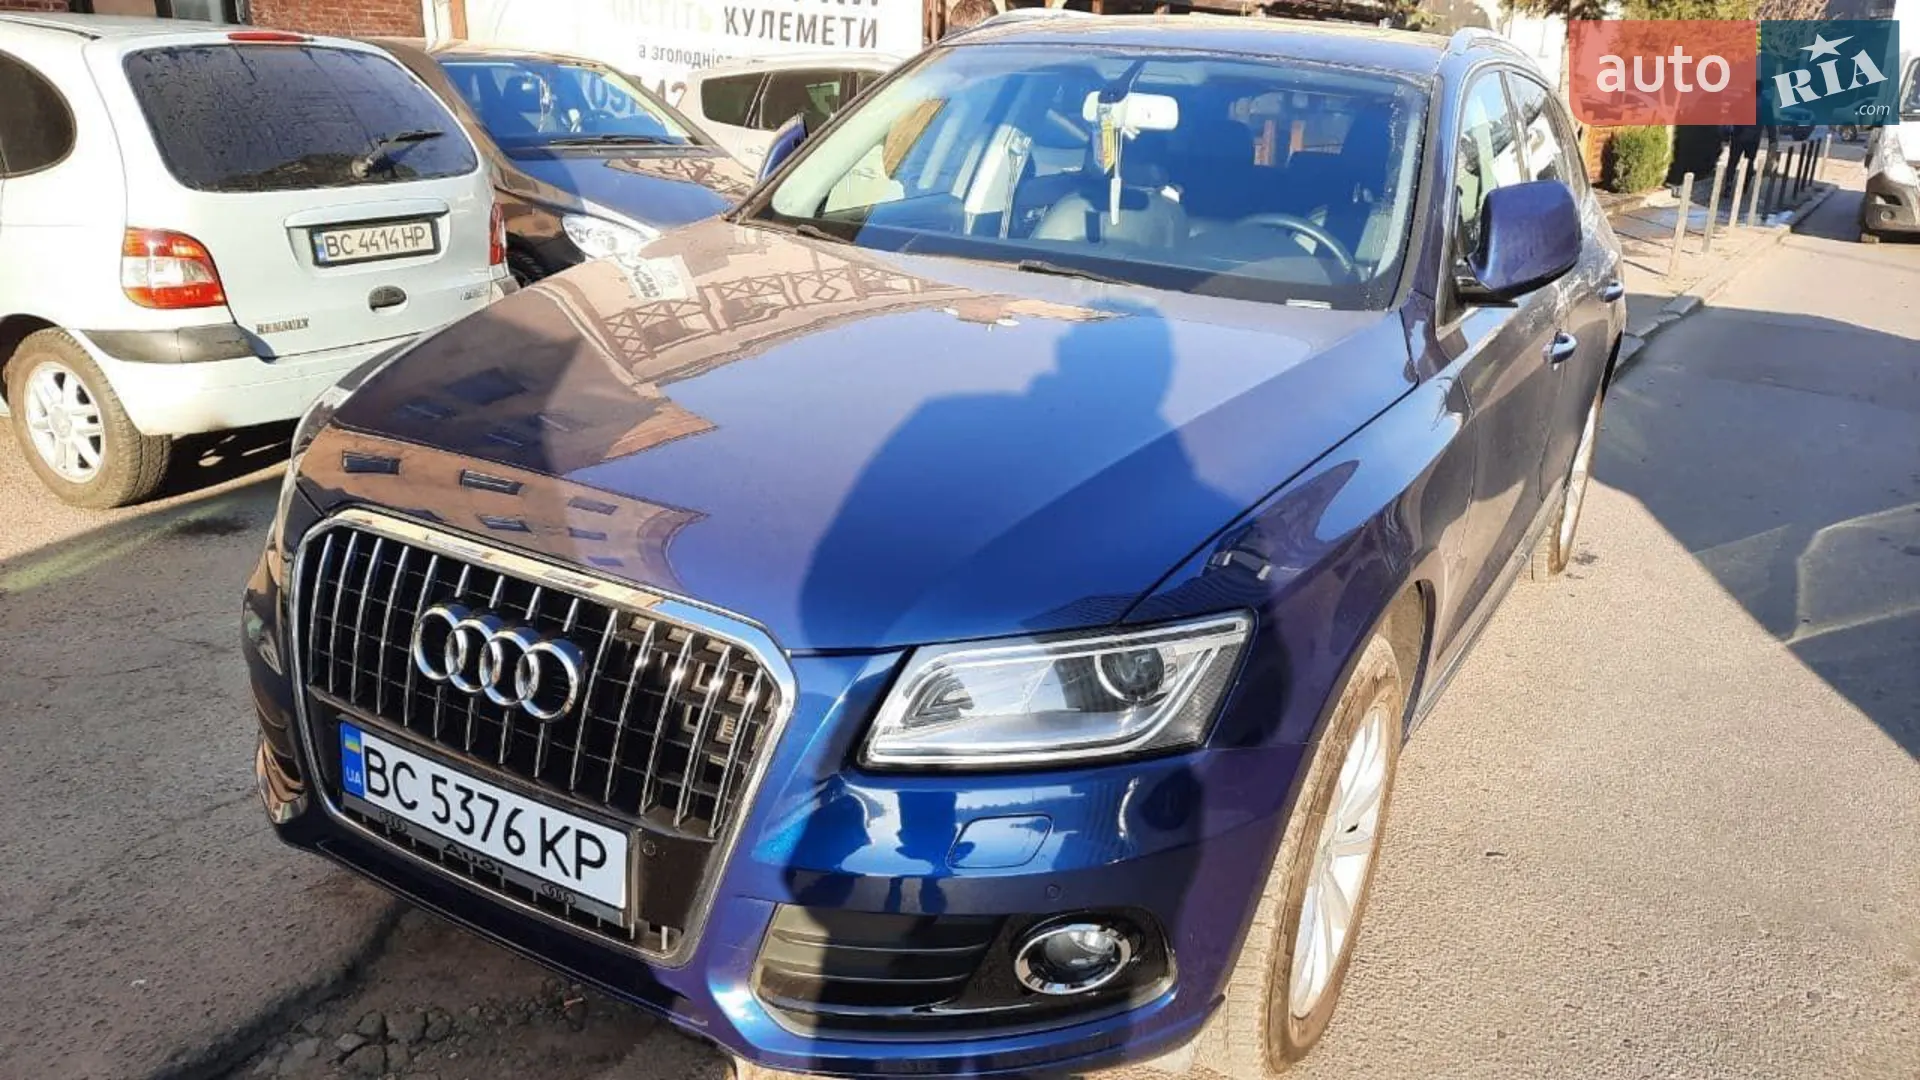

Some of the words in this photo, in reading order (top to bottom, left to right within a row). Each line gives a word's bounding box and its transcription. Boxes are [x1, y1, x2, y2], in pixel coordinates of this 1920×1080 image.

[724, 6, 877, 48] КУЛЕМЕТИ
[638, 44, 646, 59] а
[651, 46, 732, 69] зголодніс
[324, 233, 354, 257] BC
[358, 228, 400, 253] 4414
[401, 225, 426, 249] HP
[256, 317, 309, 334] RENAULT
[346, 765, 362, 787] UA
[364, 744, 418, 811] BC
[431, 773, 526, 856] 5376
[539, 816, 608, 880] KP
